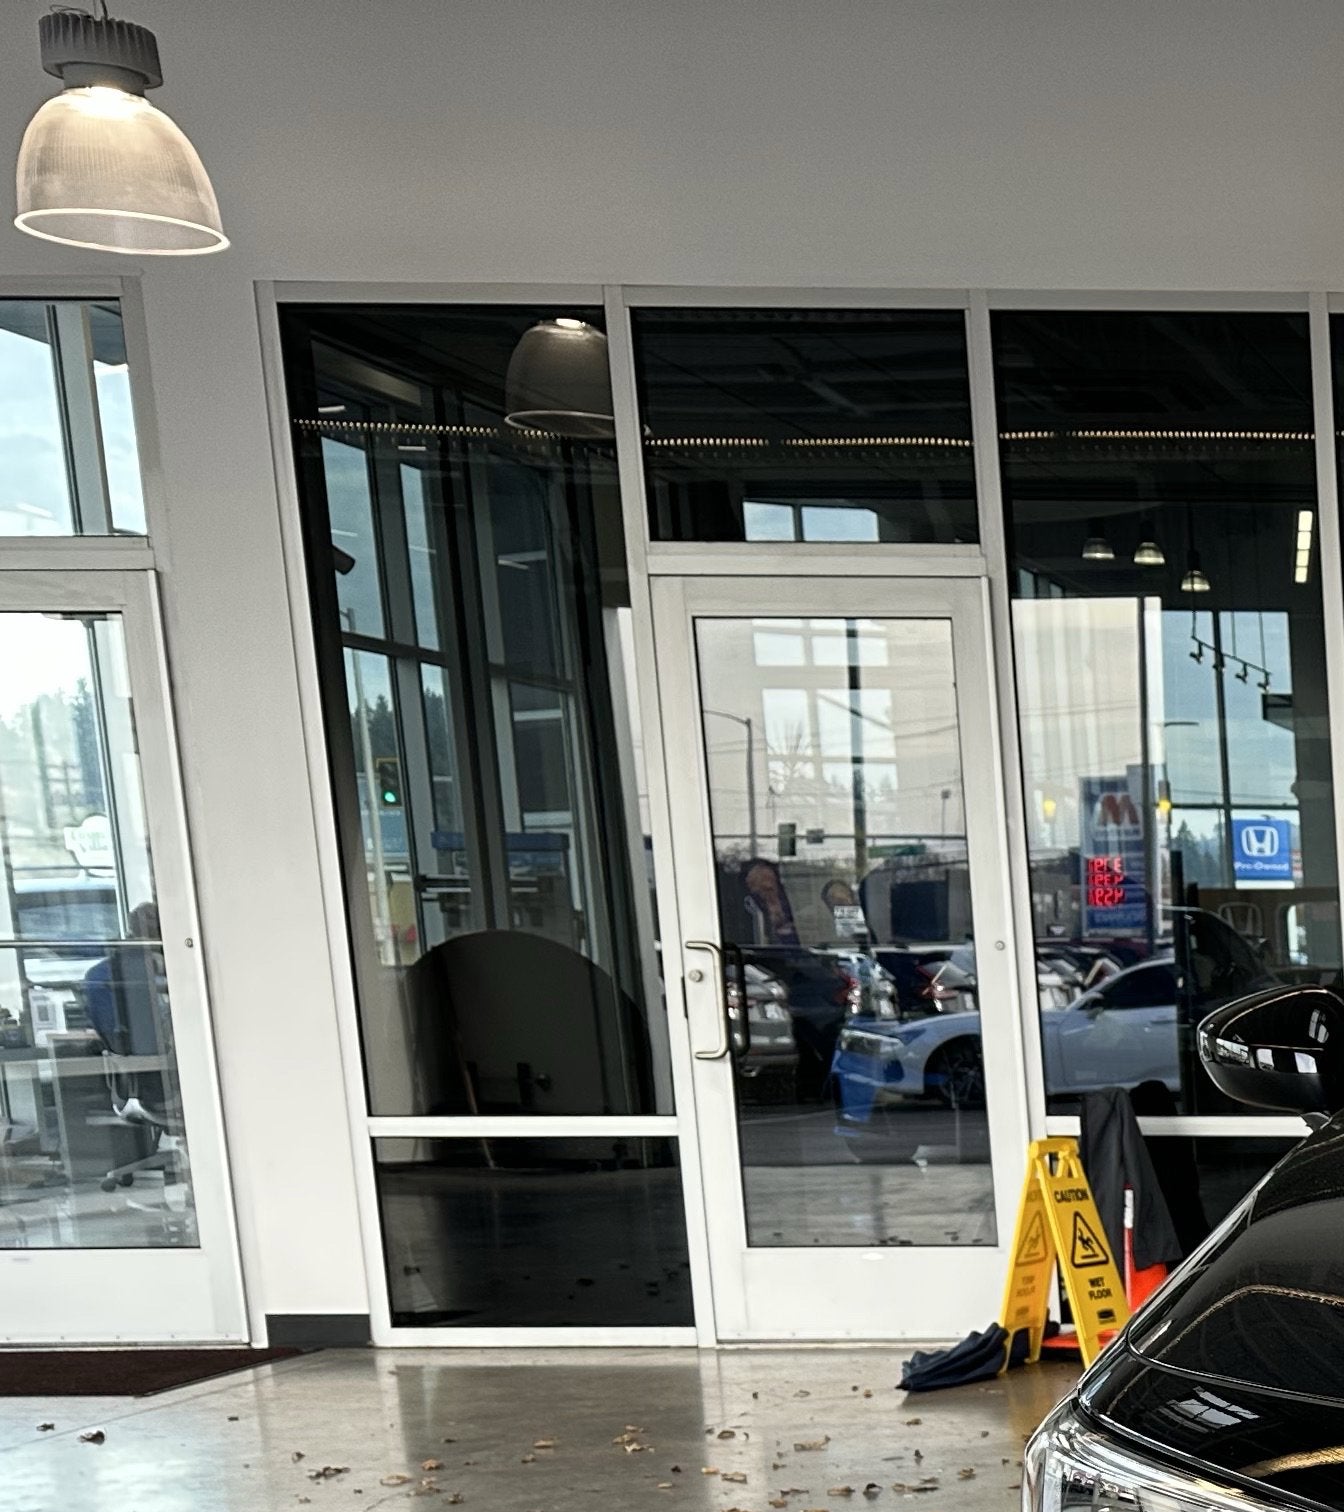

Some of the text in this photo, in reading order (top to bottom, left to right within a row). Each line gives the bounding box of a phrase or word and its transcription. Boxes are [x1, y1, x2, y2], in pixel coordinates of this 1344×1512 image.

[1054, 1188, 1089, 1203] CAUTION
[1088, 1276, 1105, 1288] WET
[1088, 1288, 1112, 1300] FLOOR
